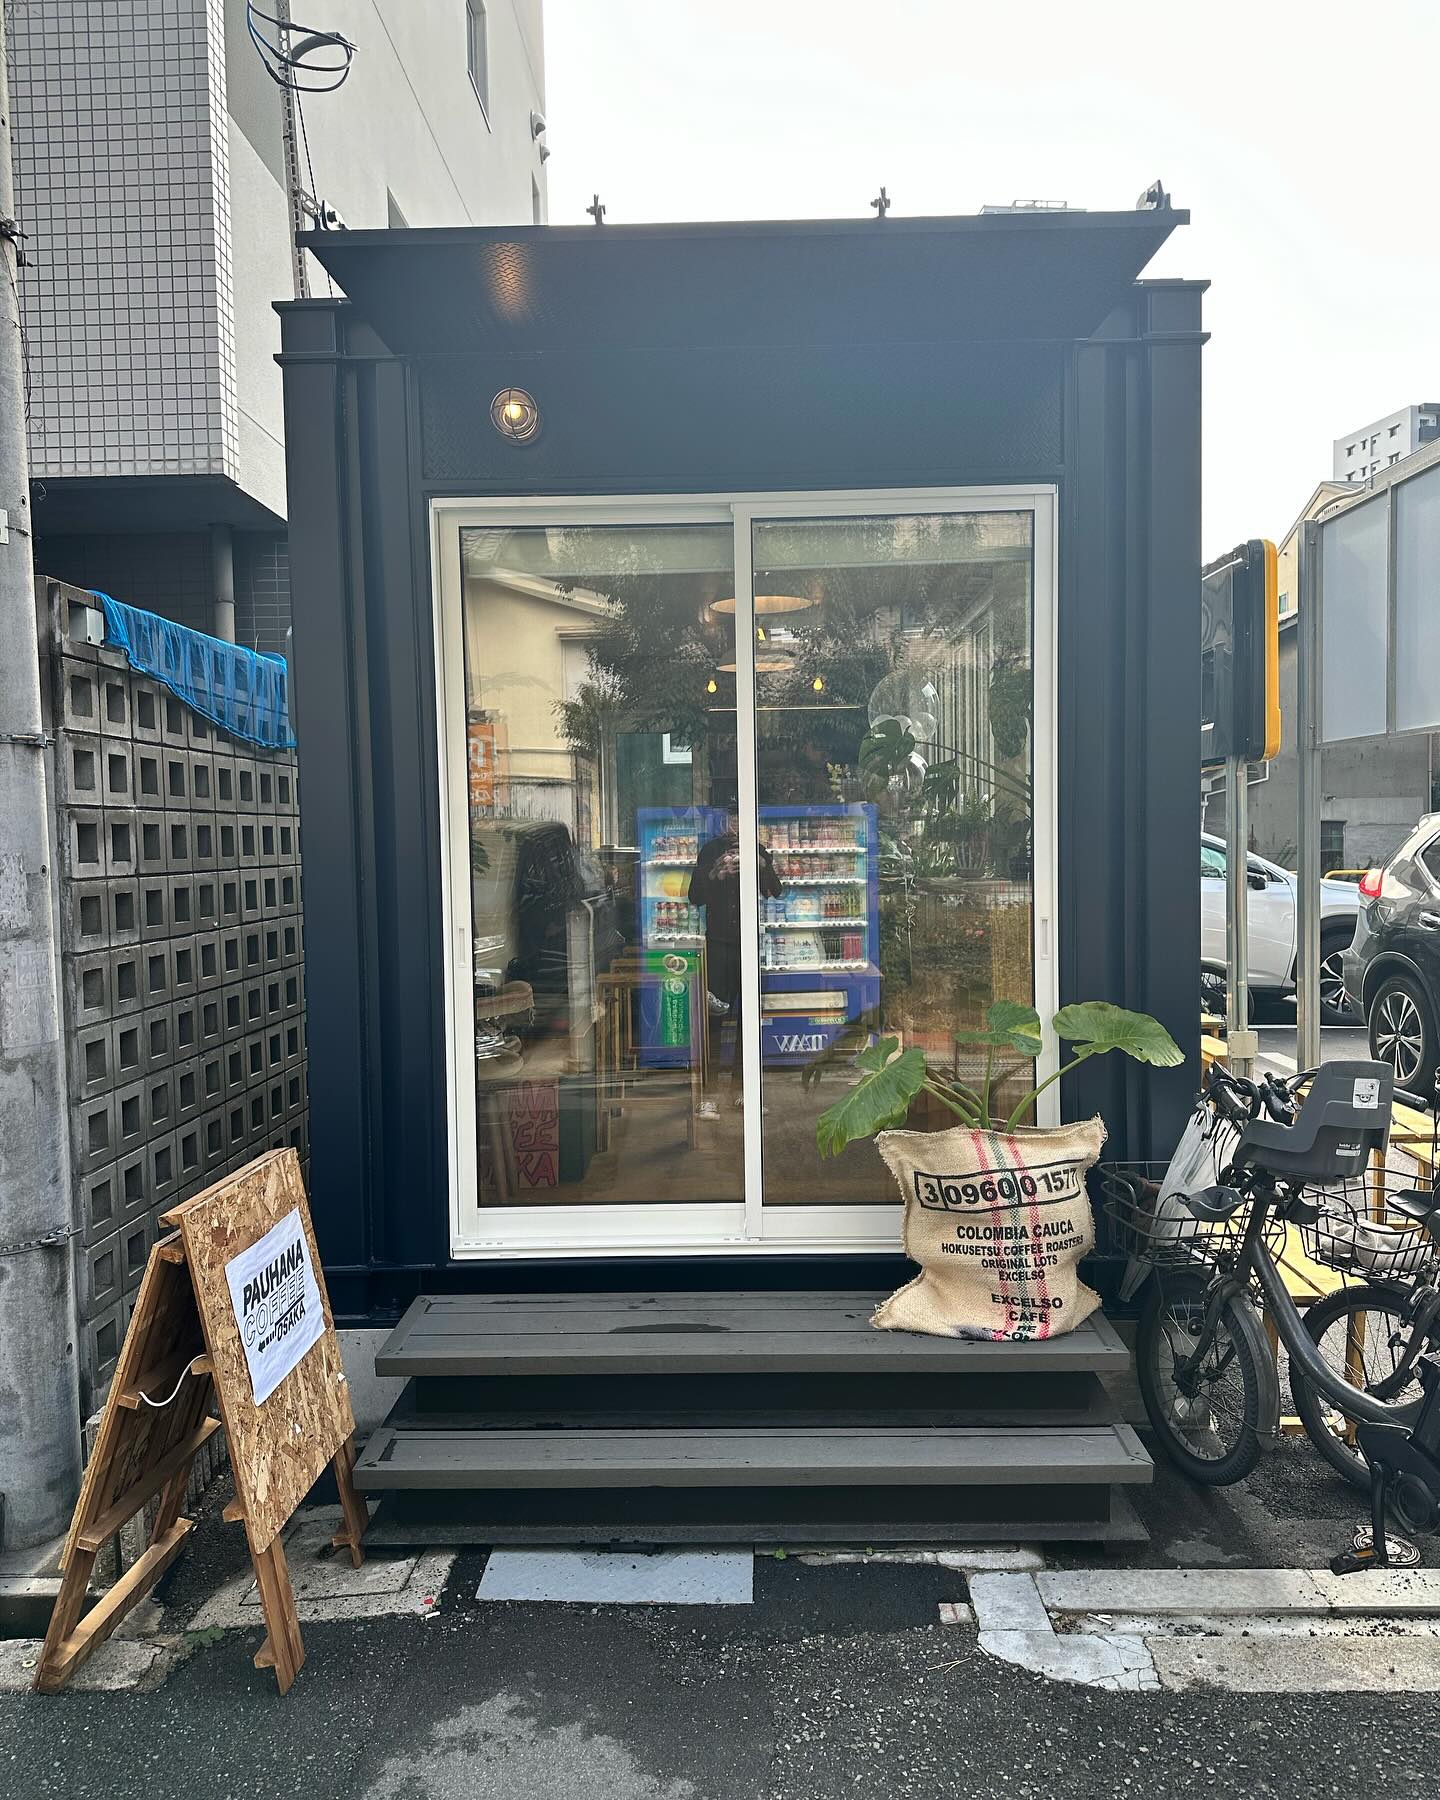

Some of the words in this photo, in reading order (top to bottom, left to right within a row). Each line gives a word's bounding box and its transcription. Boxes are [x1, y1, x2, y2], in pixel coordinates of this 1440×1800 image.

[924, 1182, 938, 1203] 3
[957, 1226, 1029, 1240] COLOMBIA
[1033, 1220, 1074, 1238] CAUCA
[941, 1243, 1000, 1256] HOKUSETSU
[1004, 1243, 1043, 1256] COFFEE
[1046, 1235, 1083, 1253] ROASTERS
[981, 1258, 1031, 1269] ORIGINAL
[1034, 1255, 1058, 1267] LOTS
[243, 1238, 304, 1318] PAUHANA
[999, 1270, 1045, 1281] EXCELSO
[244, 1265, 305, 1347] COFFEE
[991, 1293, 1063, 1309] EXCELSO
[277, 1301, 306, 1341] OSAKA
[1009, 1311, 1049, 1323] CAFE
